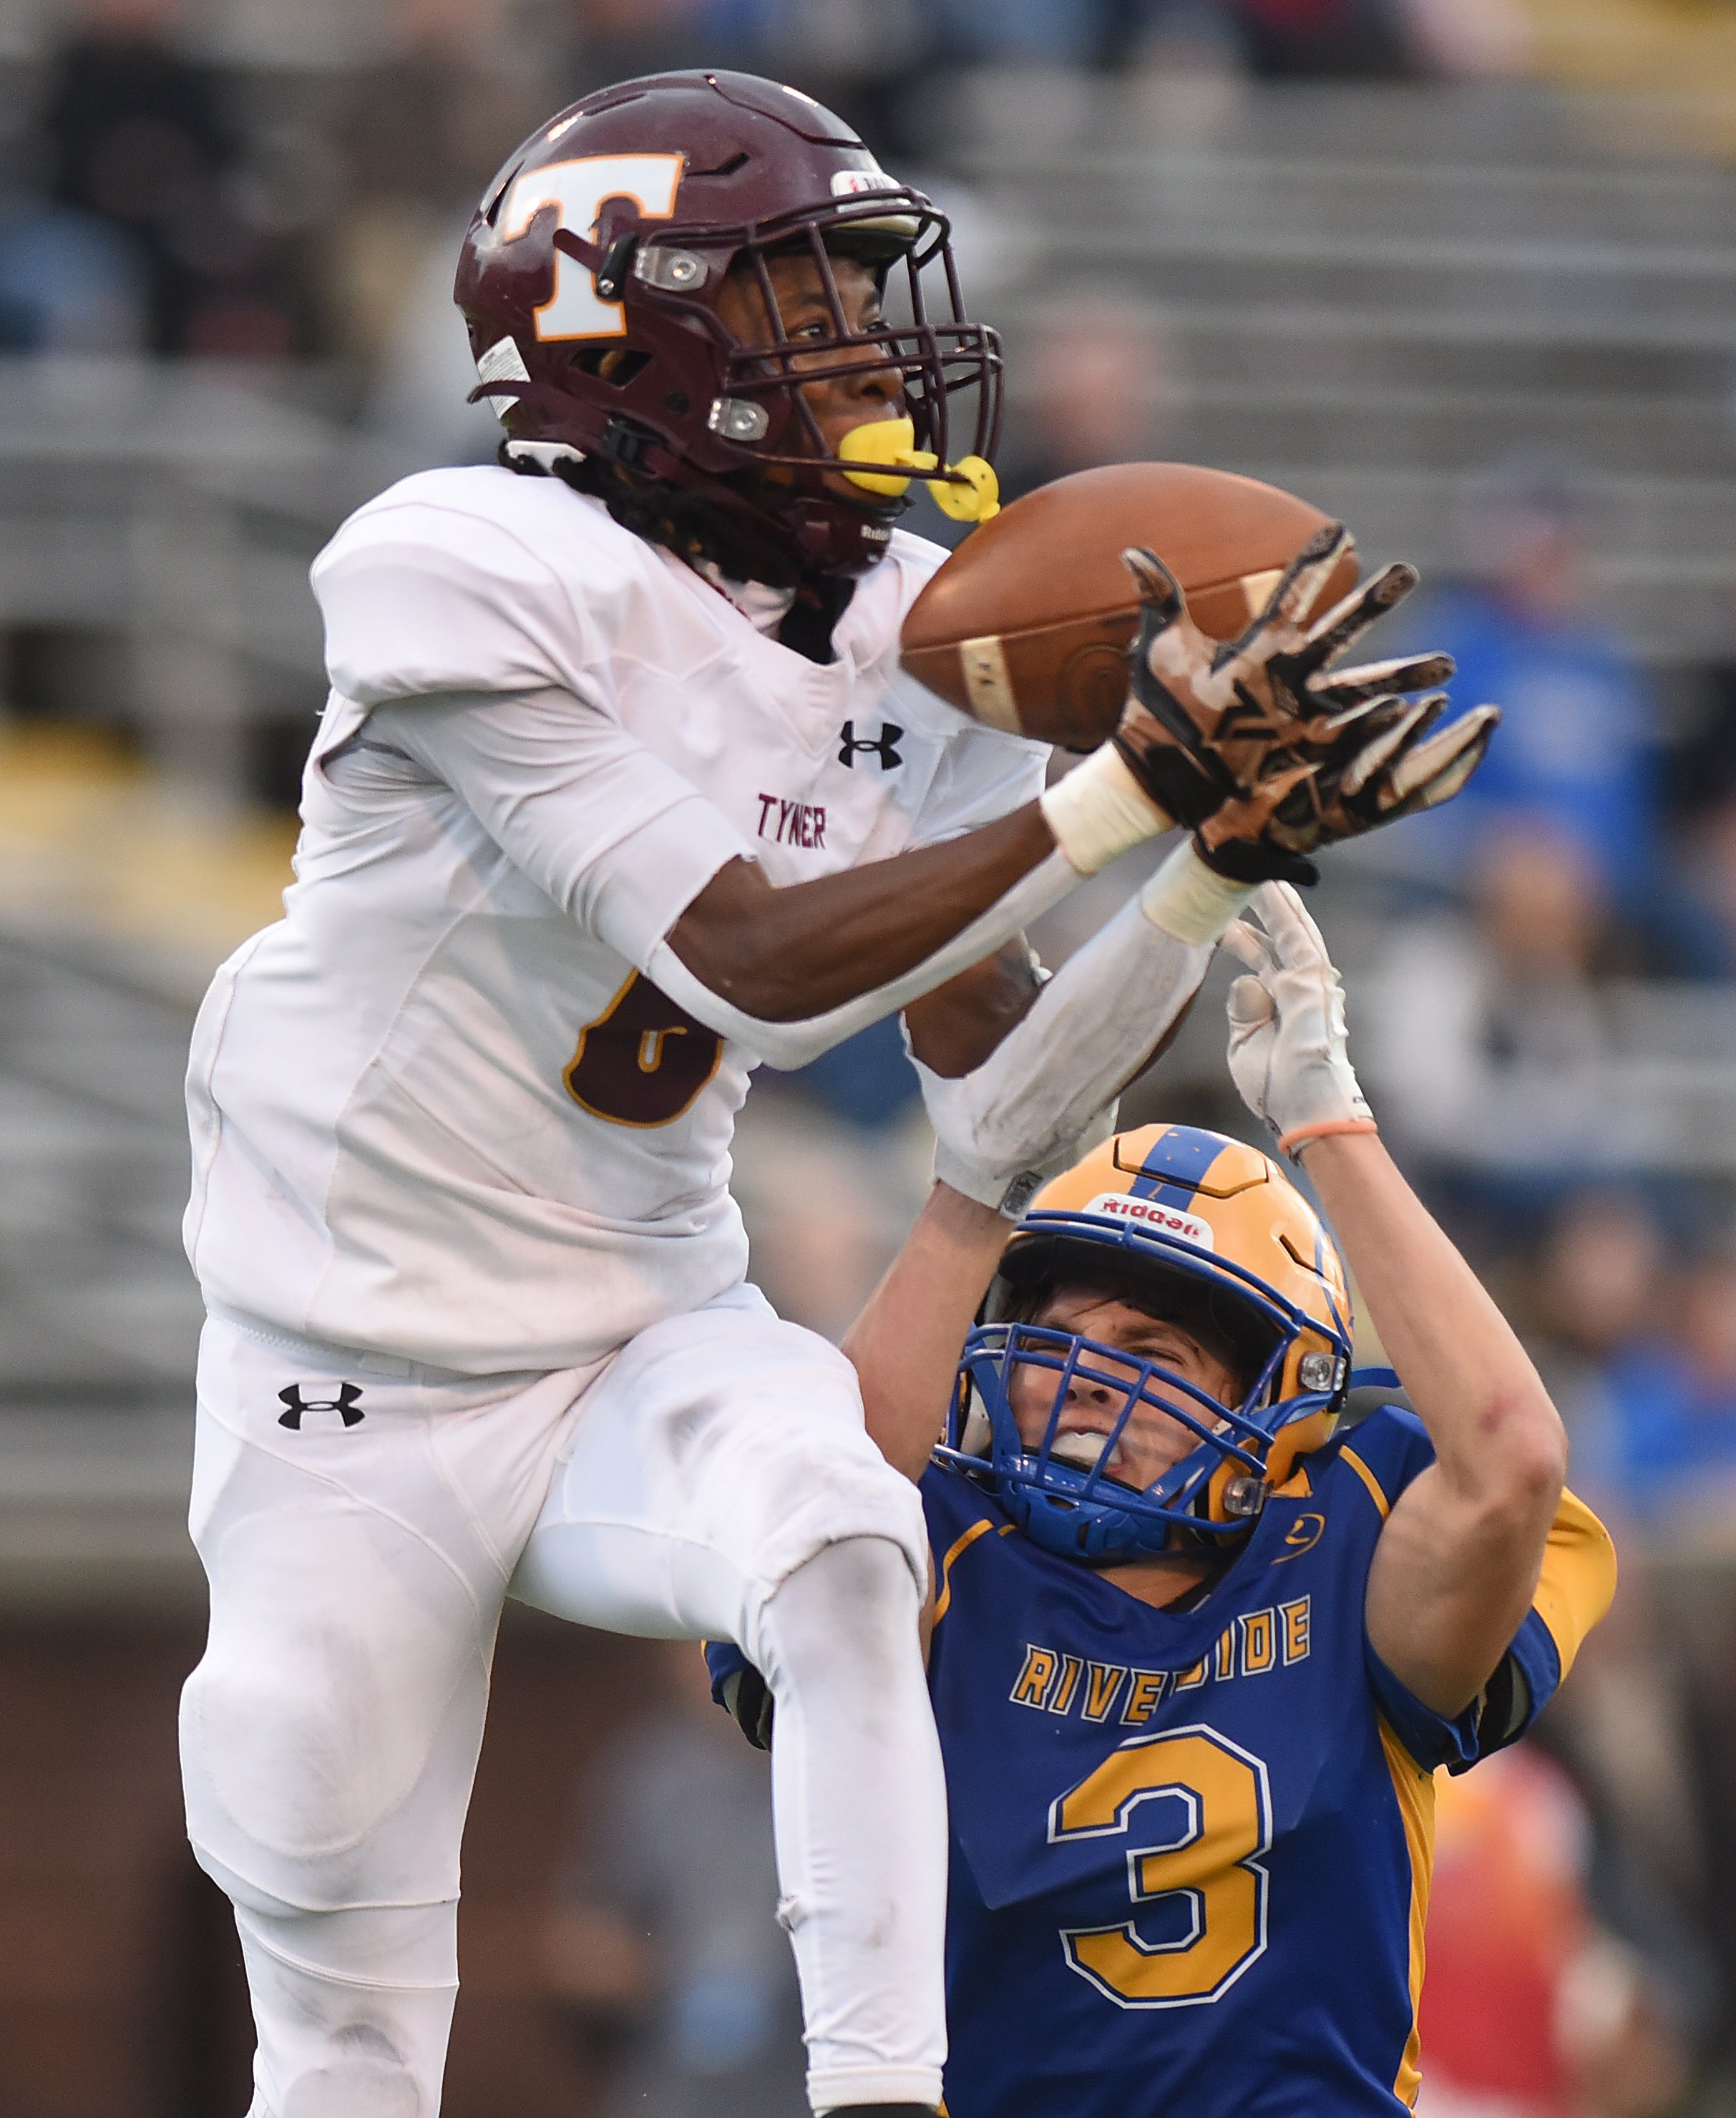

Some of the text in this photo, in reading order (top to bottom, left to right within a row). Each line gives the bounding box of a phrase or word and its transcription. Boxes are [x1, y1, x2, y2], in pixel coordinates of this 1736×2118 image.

[504, 153, 684, 342] T
[759, 793, 826, 849] TYNER
[1047, 1723, 1273, 2009] 3
